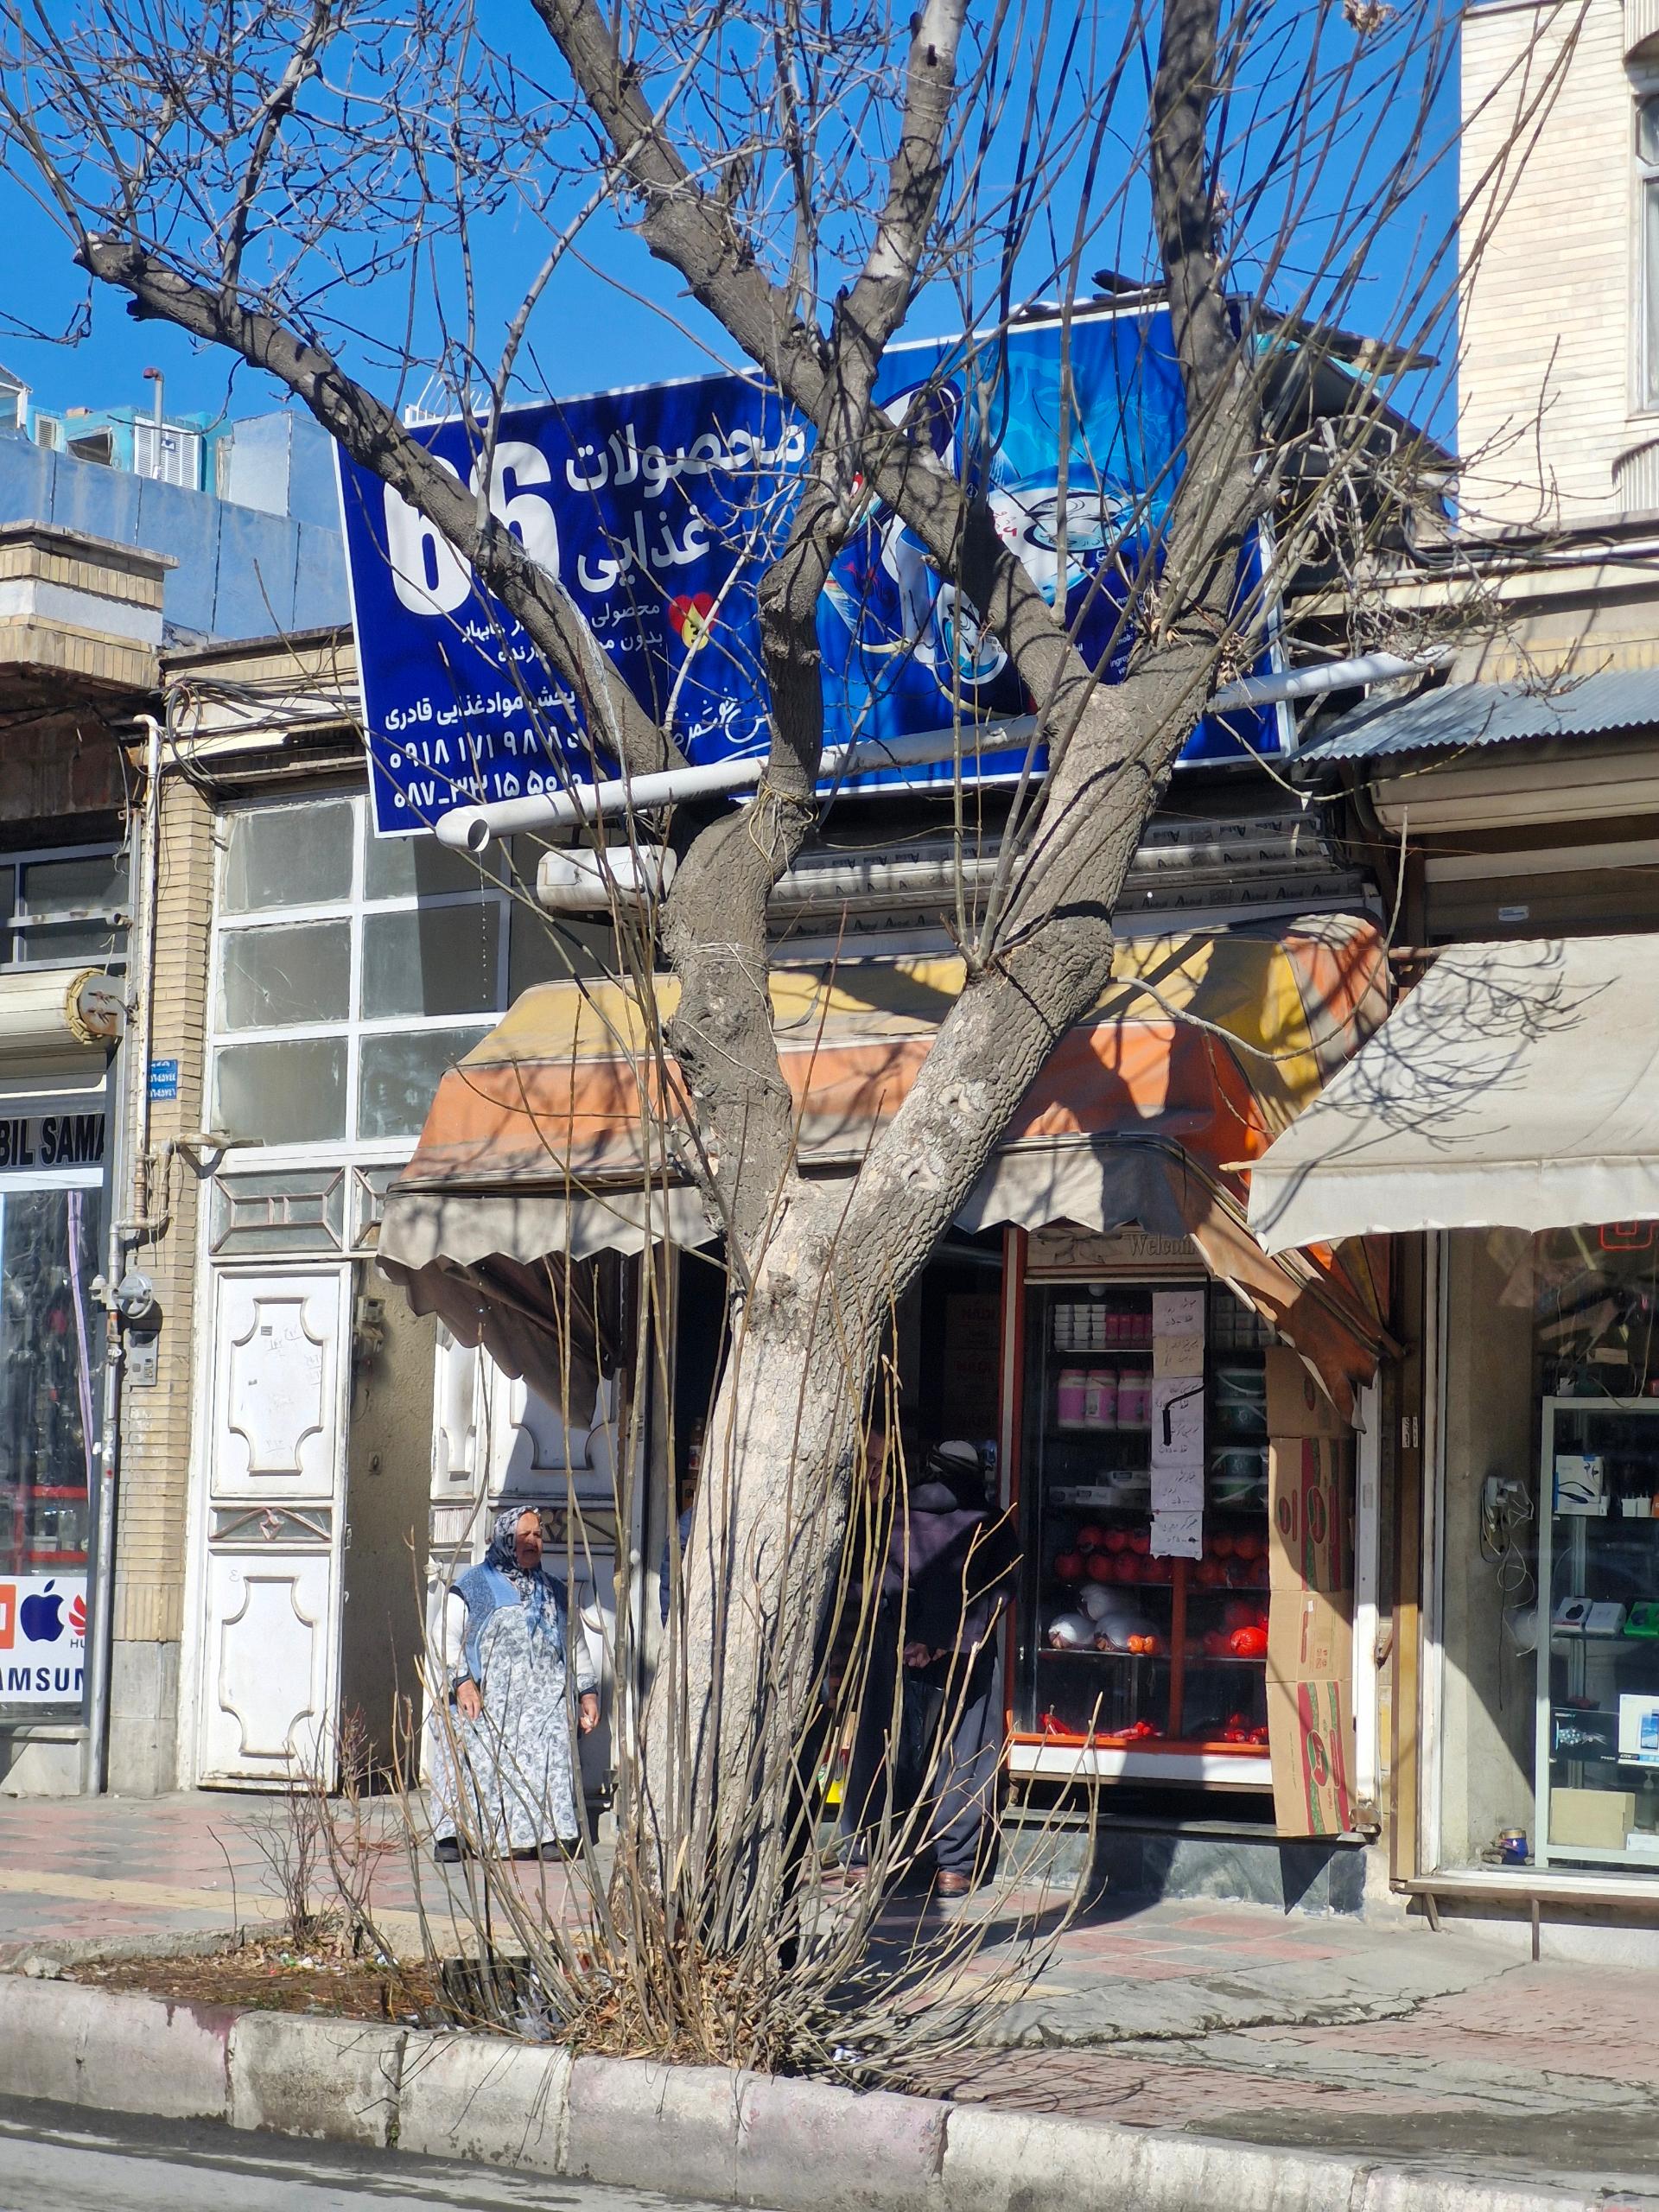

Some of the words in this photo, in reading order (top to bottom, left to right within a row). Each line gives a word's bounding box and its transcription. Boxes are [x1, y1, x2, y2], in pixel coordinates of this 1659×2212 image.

[566, 423, 805, 499] محصولات
[577, 510, 710, 593] غذایی
[385, 697, 432, 730] قادری
